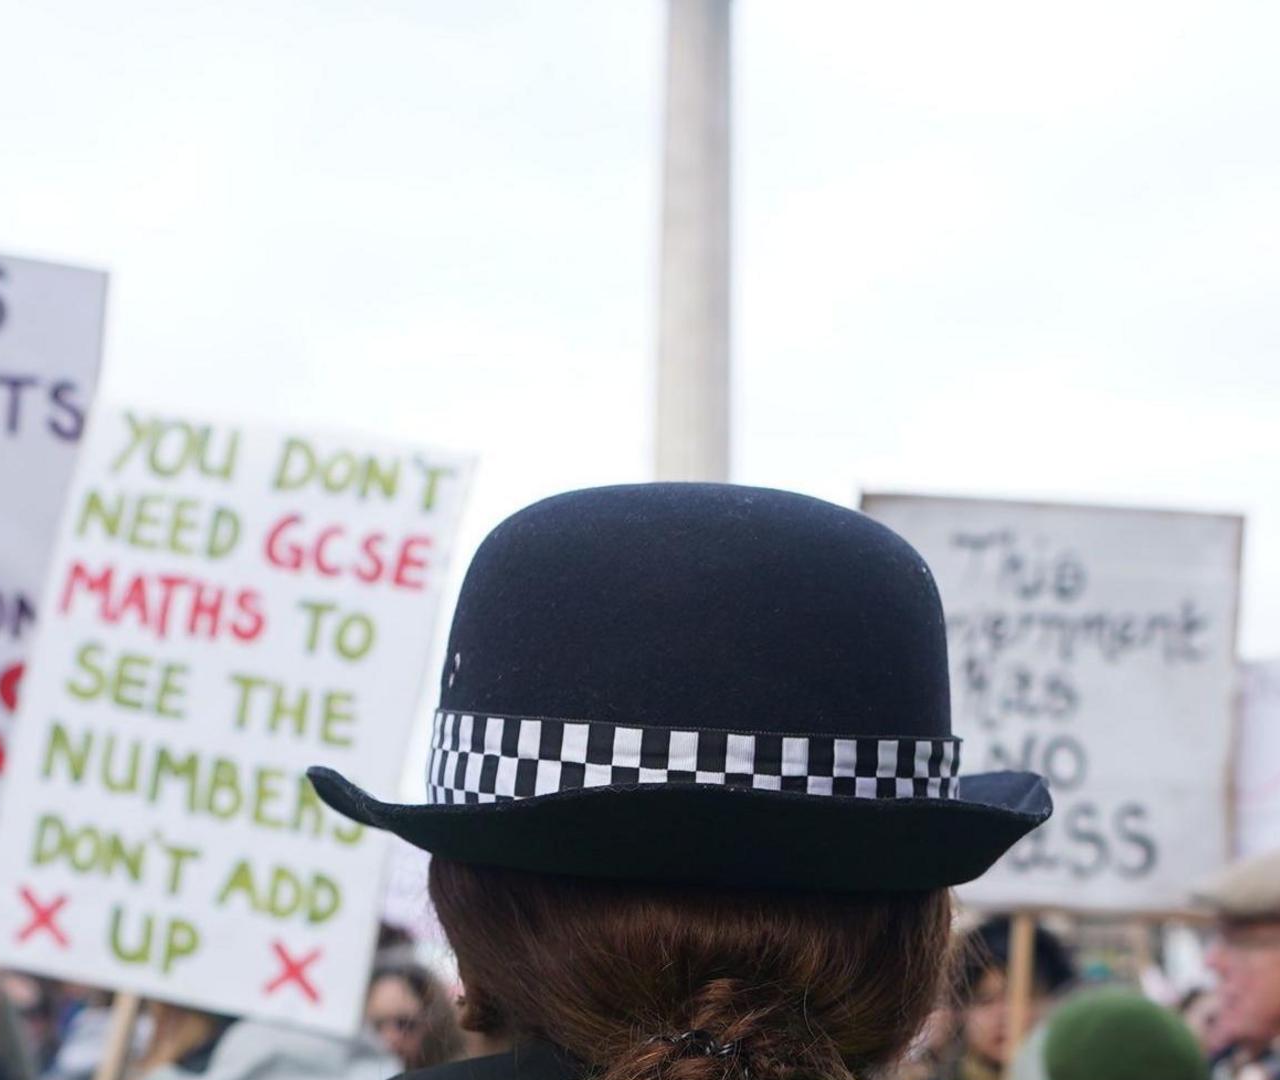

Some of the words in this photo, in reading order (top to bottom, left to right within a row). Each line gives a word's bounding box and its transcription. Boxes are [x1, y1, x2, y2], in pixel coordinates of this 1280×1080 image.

[113, 412, 239, 482] YOU
[274, 436, 454, 512] DON'T
[77, 490, 240, 560] NEED
[263, 511, 434, 591] GCSE
[59, 560, 265, 644] MATHS
[298, 599, 377, 662] TO
[66, 641, 189, 719] SEE
[230, 673, 356, 747] THE
[33, 813, 201, 896] DON'T
[216, 860, 341, 924] ADD
[109, 903, 201, 975] UP
